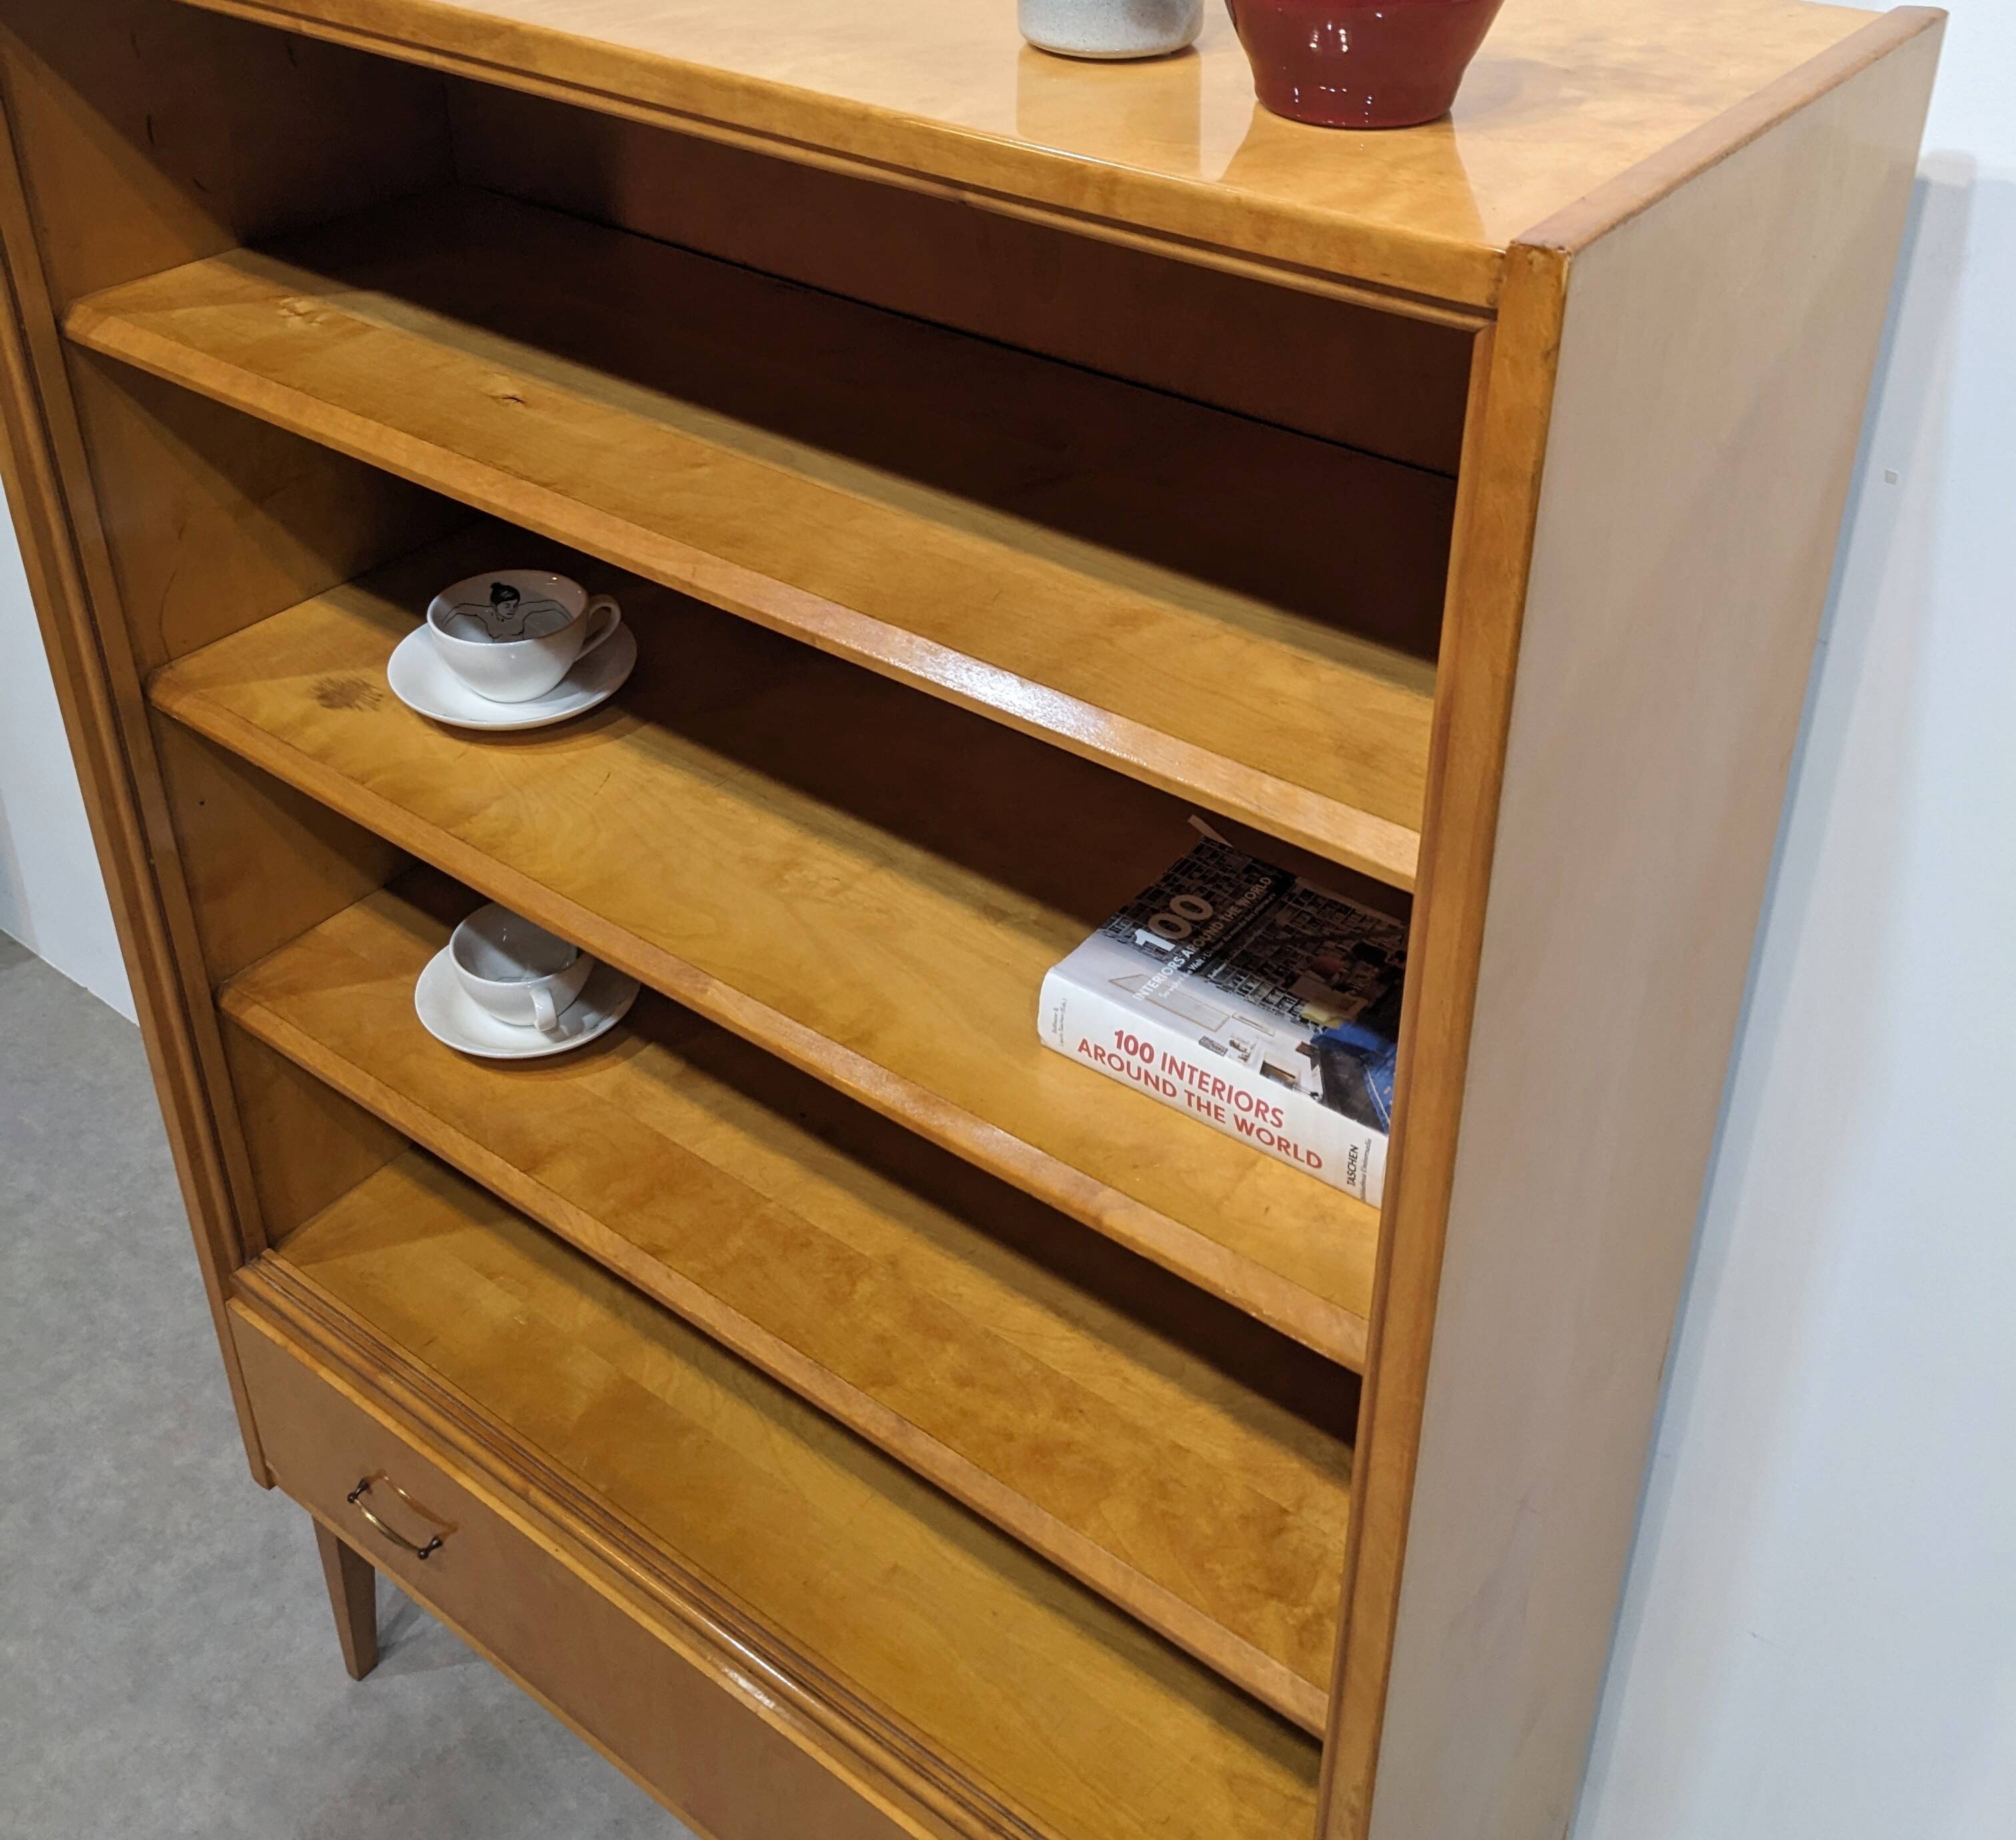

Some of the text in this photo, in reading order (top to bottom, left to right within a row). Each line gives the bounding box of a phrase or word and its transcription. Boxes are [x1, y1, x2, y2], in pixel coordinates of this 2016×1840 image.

[1133, 956, 1185, 1001] INTERIORS
[1181, 921, 1224, 959] AROUND
[1222, 906, 1242, 922] THE
[1240, 877, 1272, 906] WORLD
[1135, 894, 1213, 952] 100
[1077, 1038, 1323, 1169] AROUND THE WORLD
[1115, 1029, 1284, 1128] 100 INTERIORS
[1347, 1143, 1359, 1187] TASCHEN
